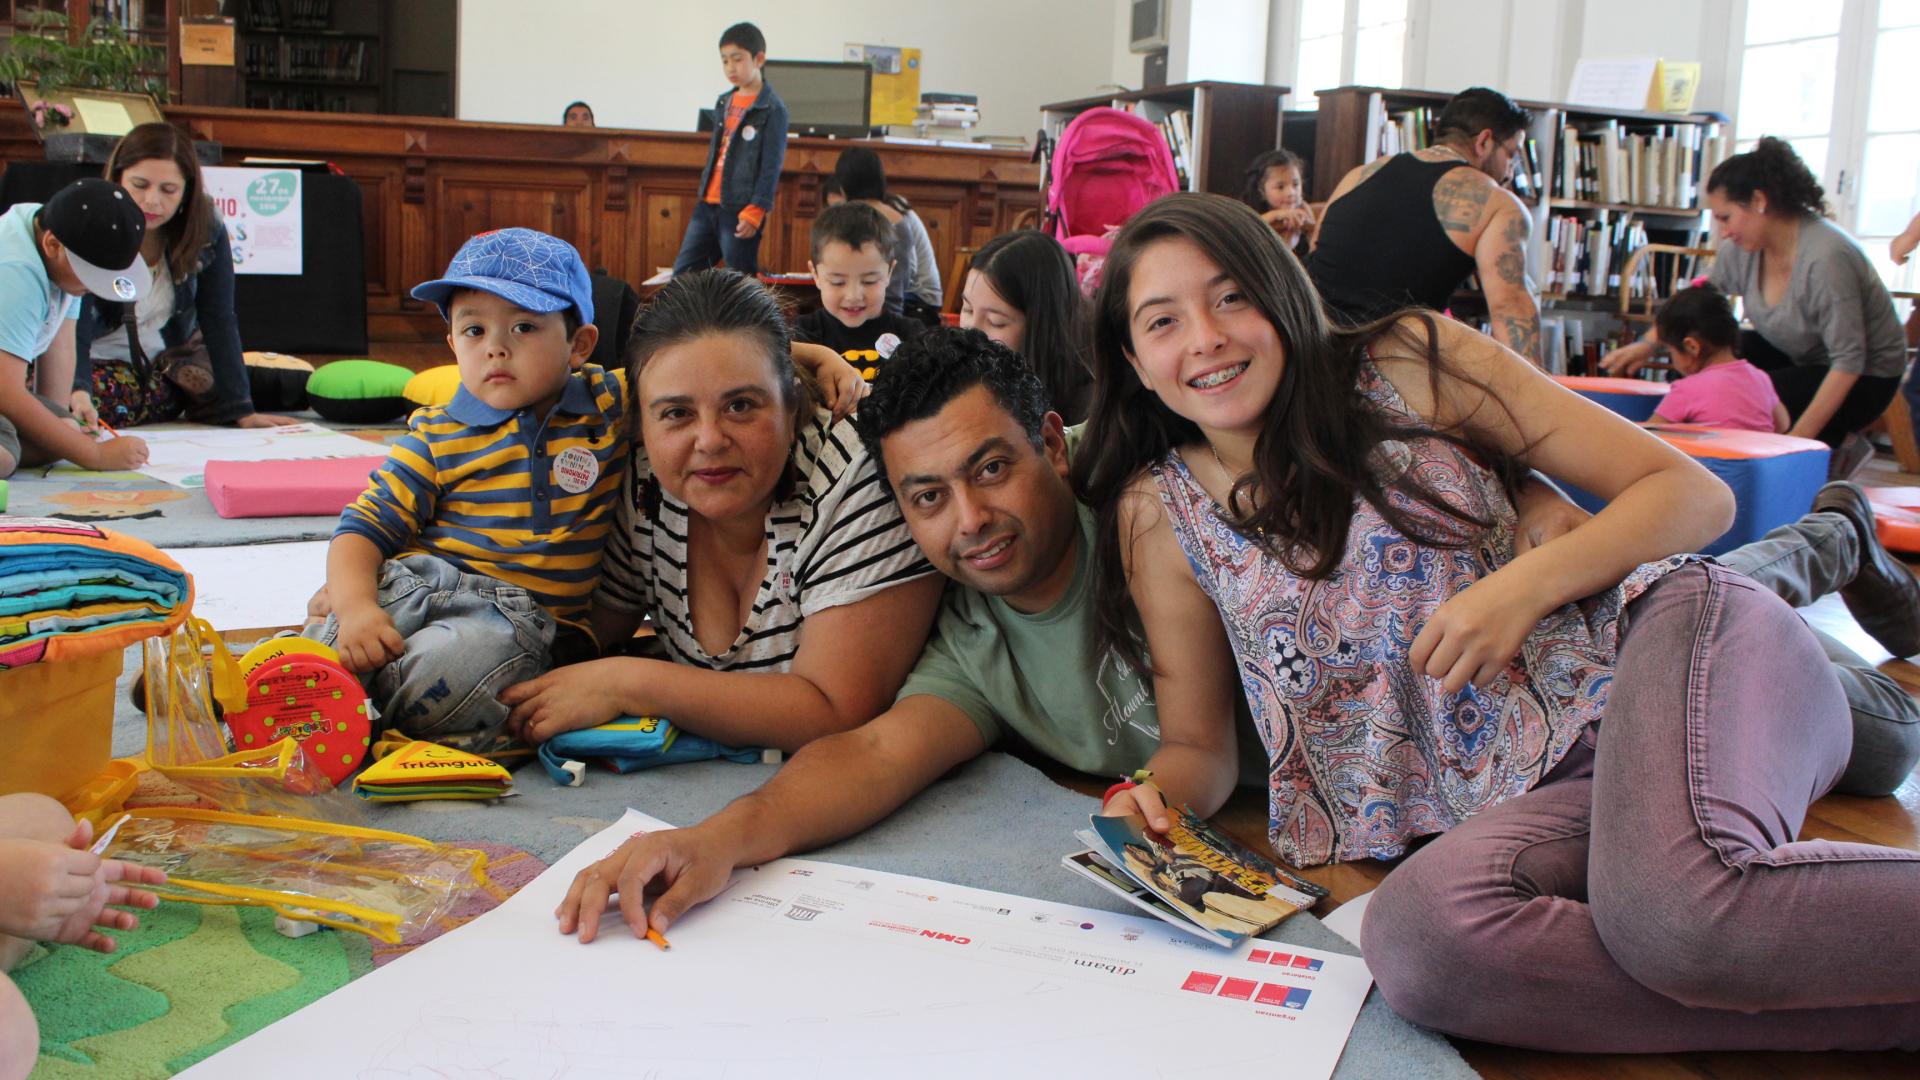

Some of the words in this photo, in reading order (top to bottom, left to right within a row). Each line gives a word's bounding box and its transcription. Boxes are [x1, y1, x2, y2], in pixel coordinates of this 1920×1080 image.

[255, 178, 281, 195] 27
[399, 759, 497, 770] Triángulo
[919, 929, 972, 945] CMN
[1074, 959, 1137, 976] dibam
